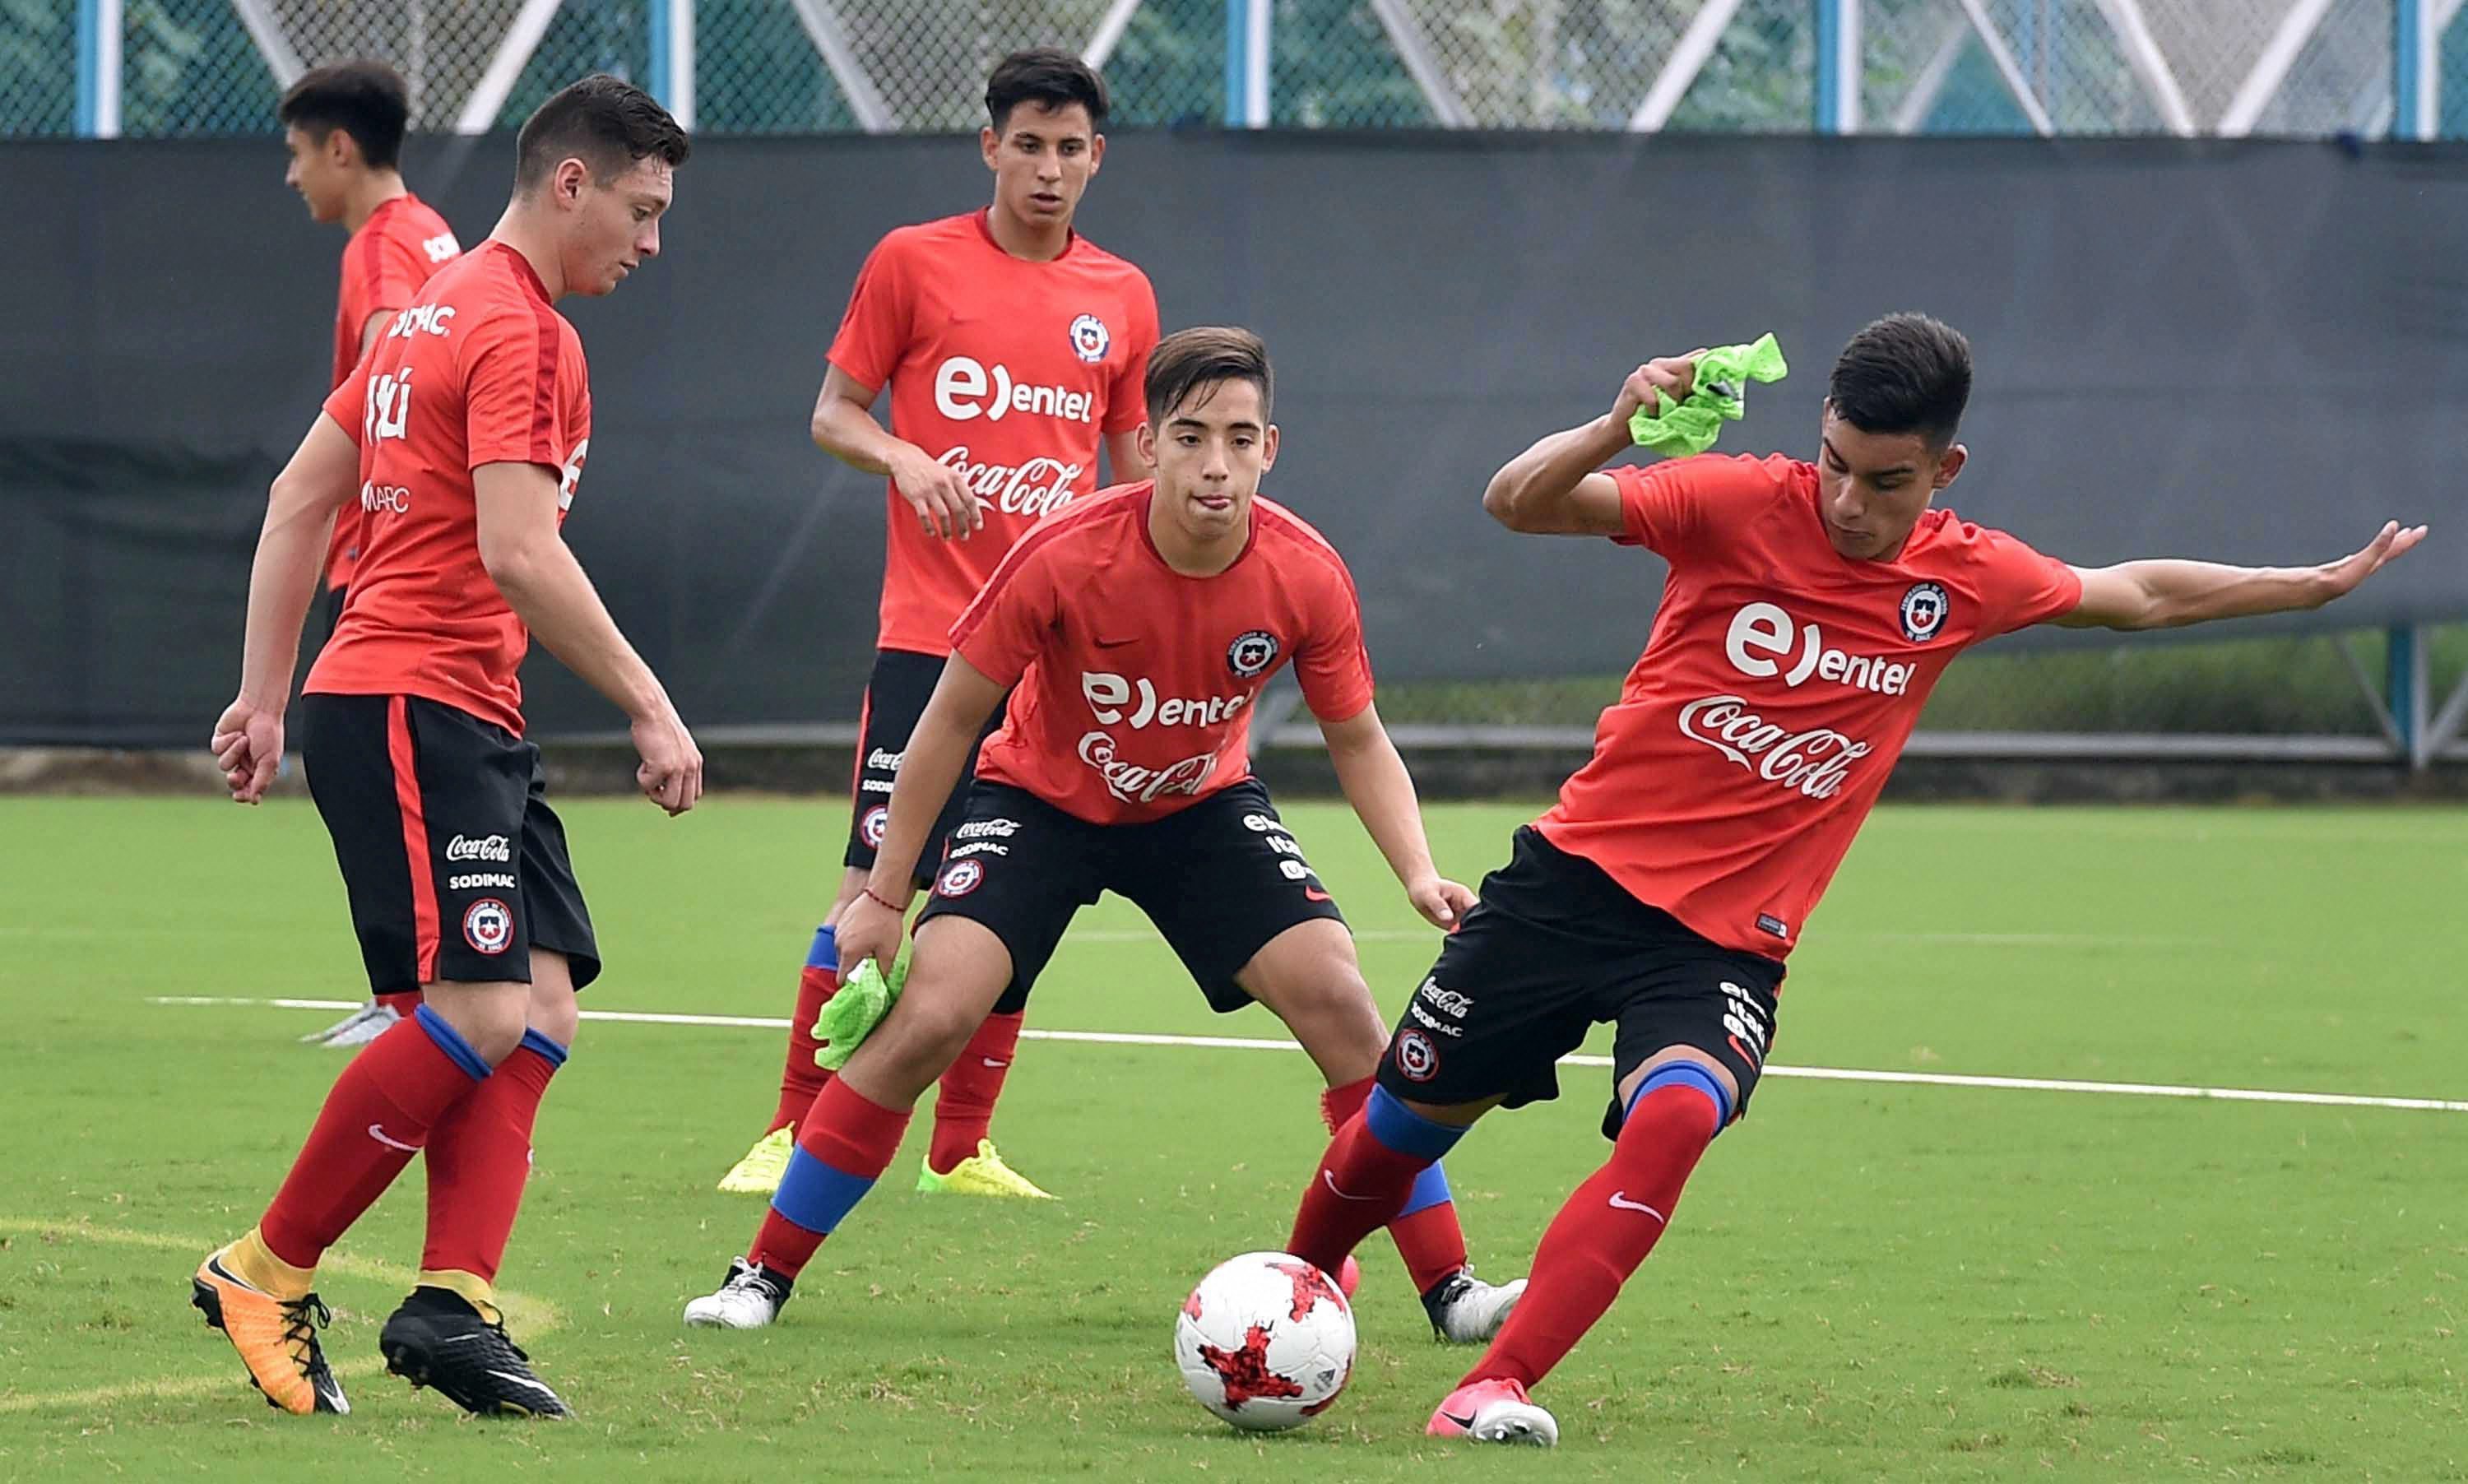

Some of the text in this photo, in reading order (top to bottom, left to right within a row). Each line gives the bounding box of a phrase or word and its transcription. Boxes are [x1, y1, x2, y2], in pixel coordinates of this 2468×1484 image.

[1678, 695, 1873, 800] Coca-Cola
[446, 833, 511, 862] Coca-Cola
[449, 873, 516, 889] SODIMAC
[1421, 976, 1474, 1019] Coca-Cola
